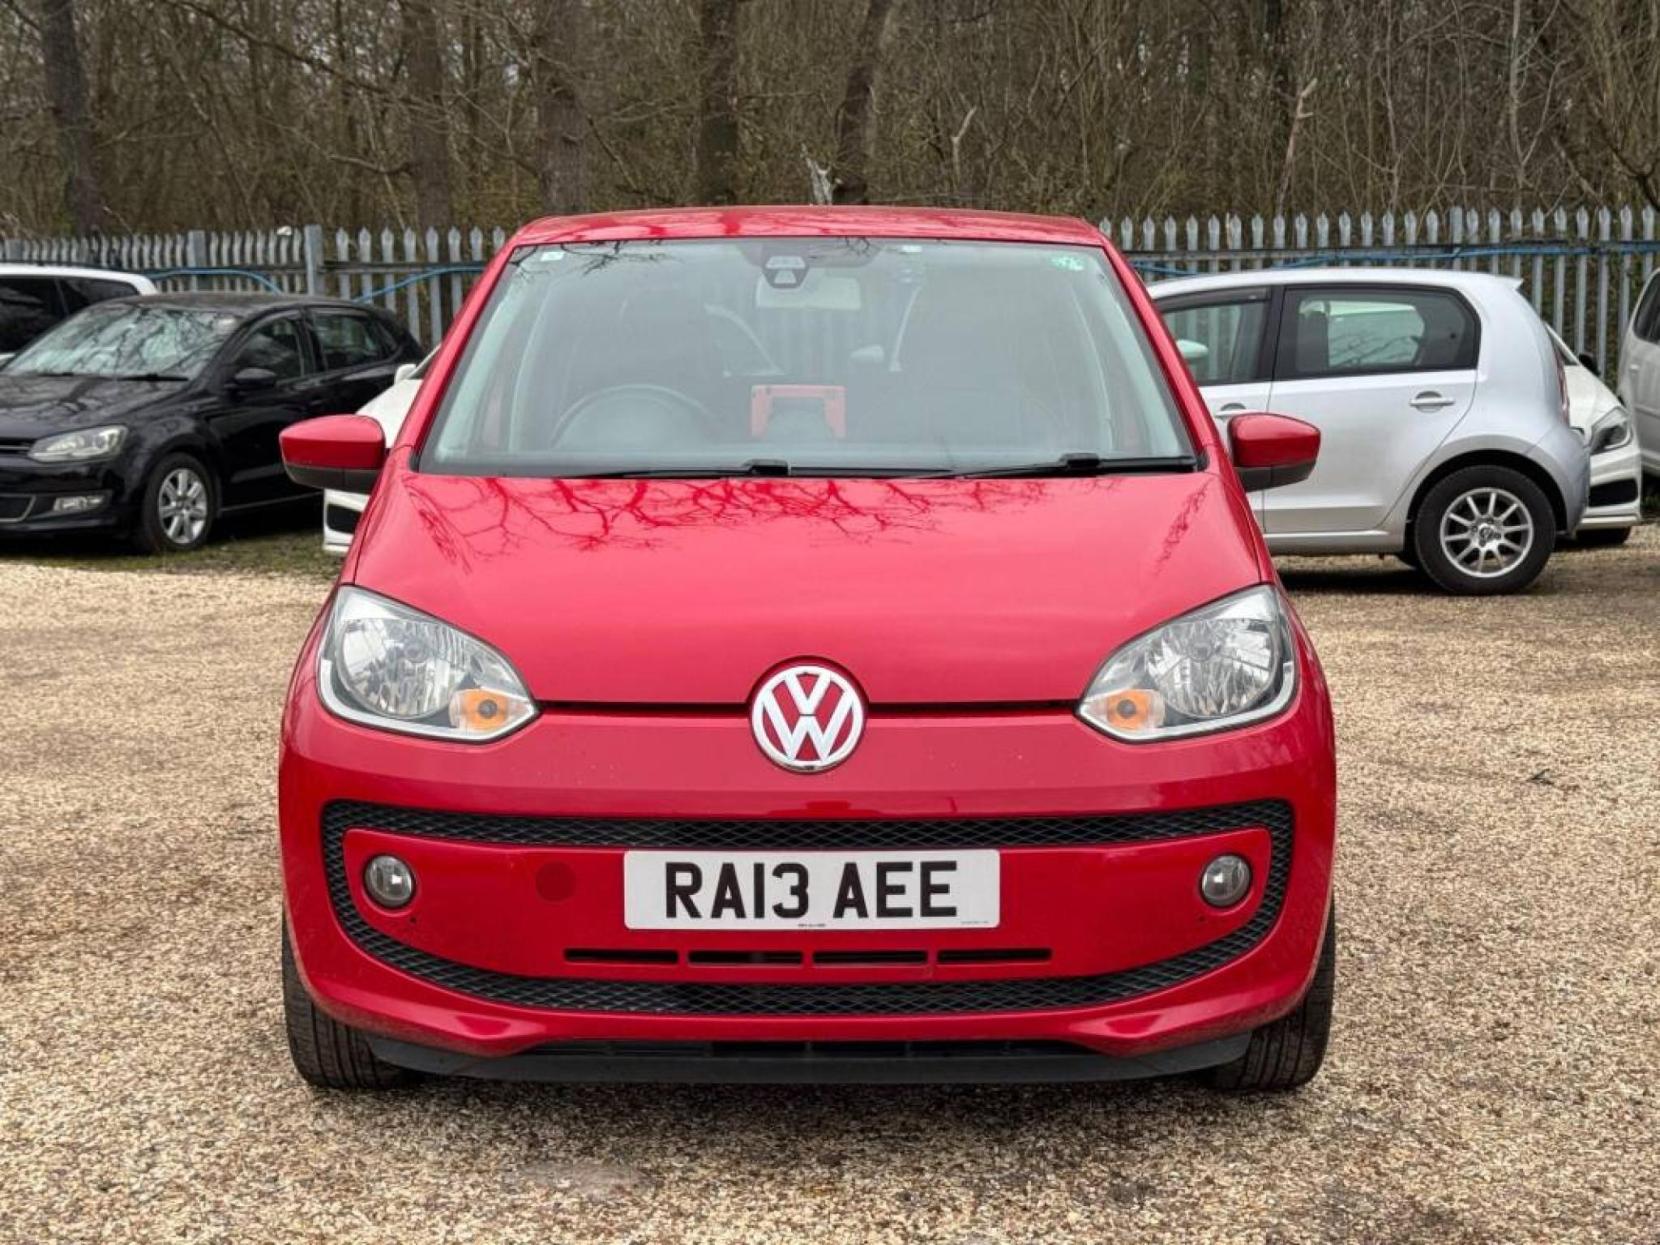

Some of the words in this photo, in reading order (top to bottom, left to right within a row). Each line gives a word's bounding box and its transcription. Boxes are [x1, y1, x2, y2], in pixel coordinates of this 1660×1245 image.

[754, 667, 863, 767] VW
[665, 861, 809, 919] RA13
[832, 860, 958, 919] AEE
